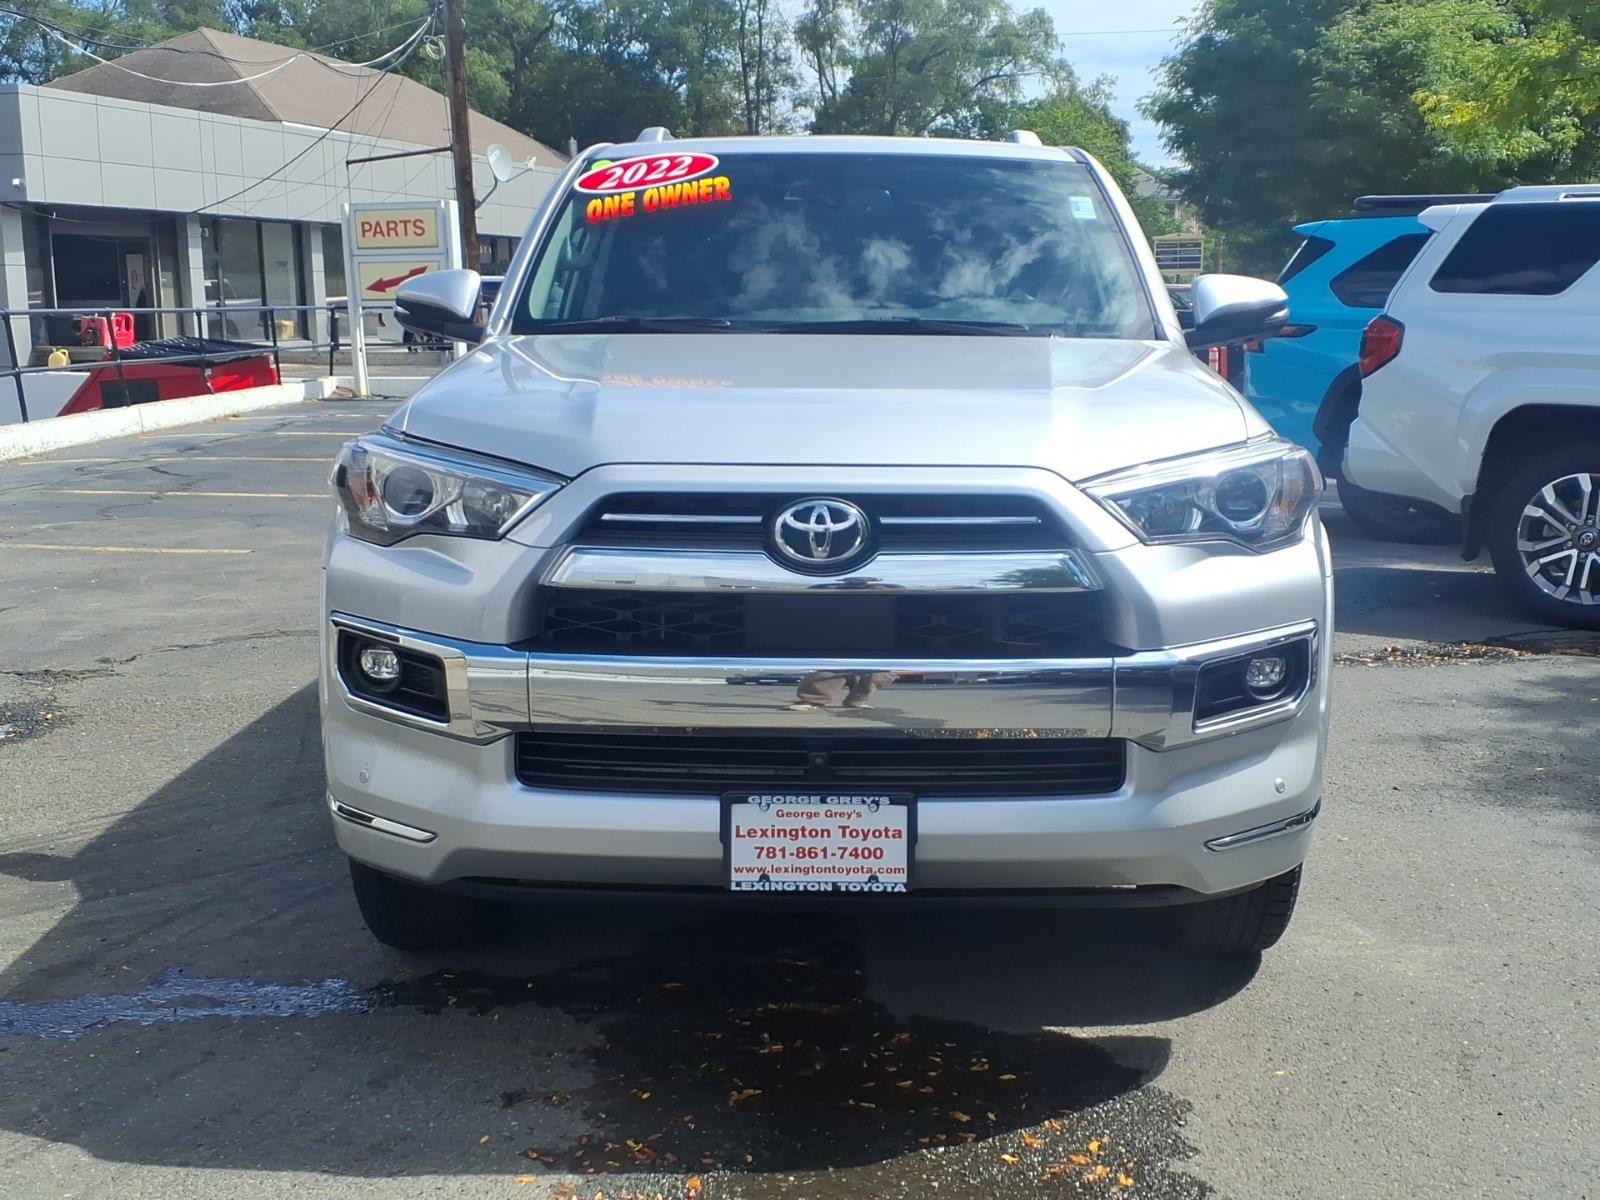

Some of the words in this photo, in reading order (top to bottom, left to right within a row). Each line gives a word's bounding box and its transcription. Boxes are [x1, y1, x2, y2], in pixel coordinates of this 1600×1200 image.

[597, 156, 694, 189] 2022
[586, 191, 636, 224] ONE
[643, 176, 732, 212] OWNER
[360, 218, 426, 238] PARTS
[747, 795, 821, 805] GEORGE
[826, 796, 891, 806] GREY'S
[776, 809, 820, 819] George
[824, 809, 863, 820] Grey's
[735, 825, 831, 841] Lexington
[838, 825, 903, 841] Toyota
[754, 846, 884, 860] 781-861-7400
[734, 864, 905, 875] www.lexingtontoyota.com
[731, 881, 833, 891] LEXINGTON
[838, 882, 907, 892] TOYOTA
